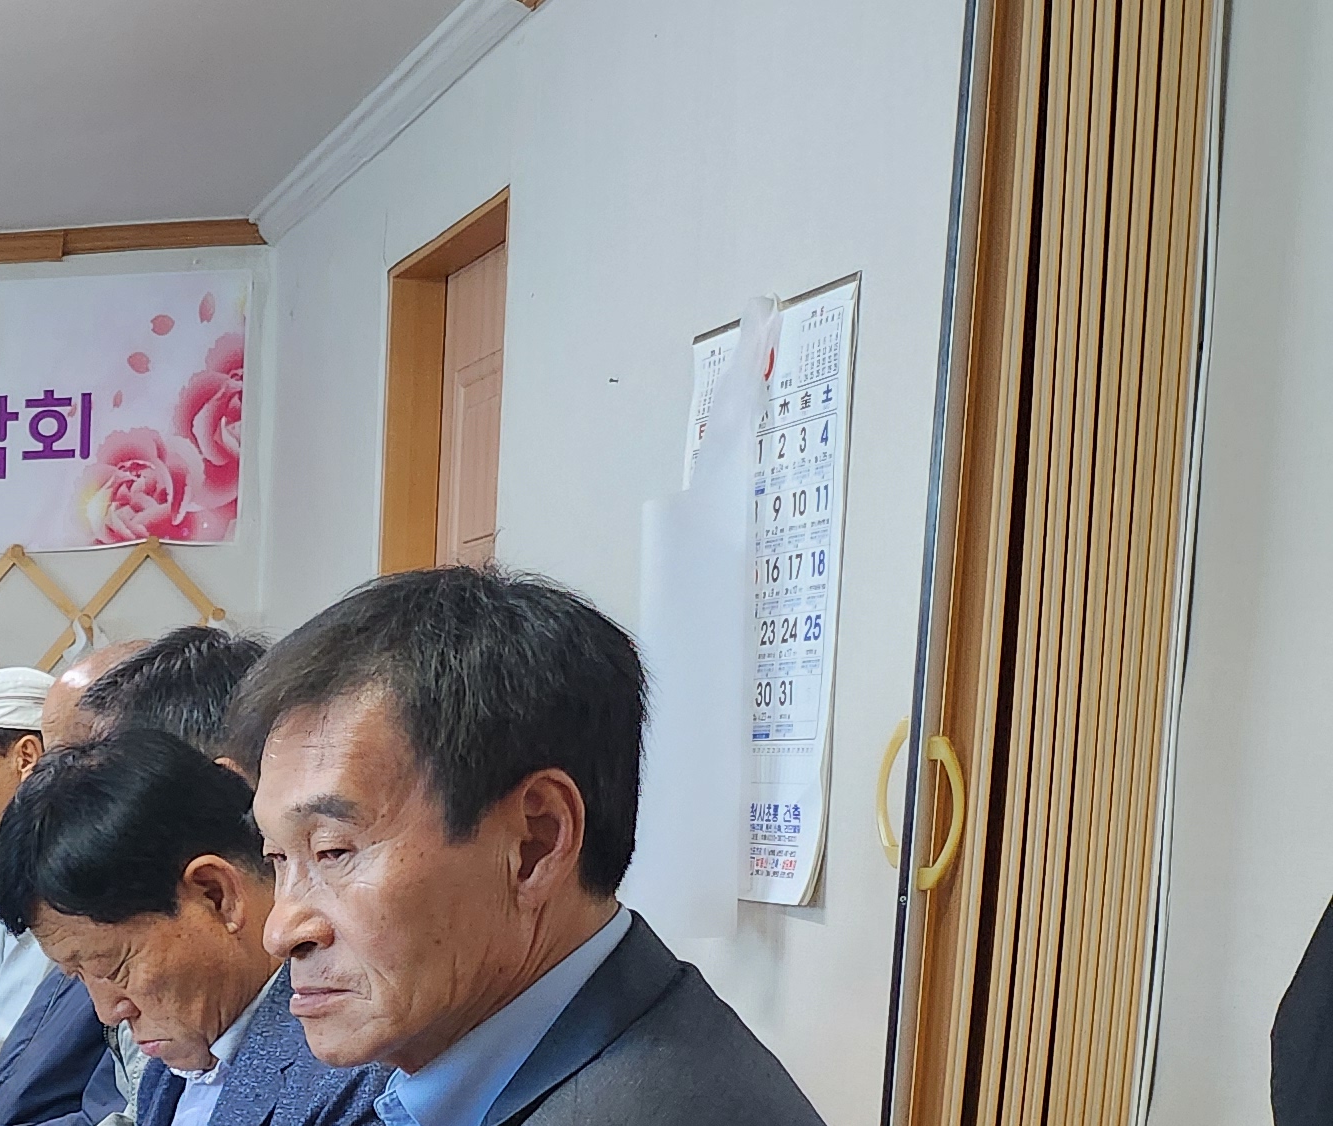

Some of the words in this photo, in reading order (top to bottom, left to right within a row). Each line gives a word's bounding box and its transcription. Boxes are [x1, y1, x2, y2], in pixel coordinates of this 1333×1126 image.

[799, 391, 812, 411] 金
[821, 383, 833, 404] 土
[757, 438, 764, 465] 1
[777, 432, 787, 460] 2
[799, 426, 808, 454] 3
[819, 419, 829, 447] 4
[772, 495, 782, 522] 9
[791, 489, 807, 518] 10
[815, 484, 829, 513] 11
[765, 556, 781, 585] 16
[787, 552, 804, 581] 17
[810, 549, 826, 578] 18
[759, 619, 776, 646] 23
[780, 616, 798, 644] 24
[803, 613, 822, 642] 25
[755, 681, 772, 708] 30
[778, 679, 794, 707] 31
